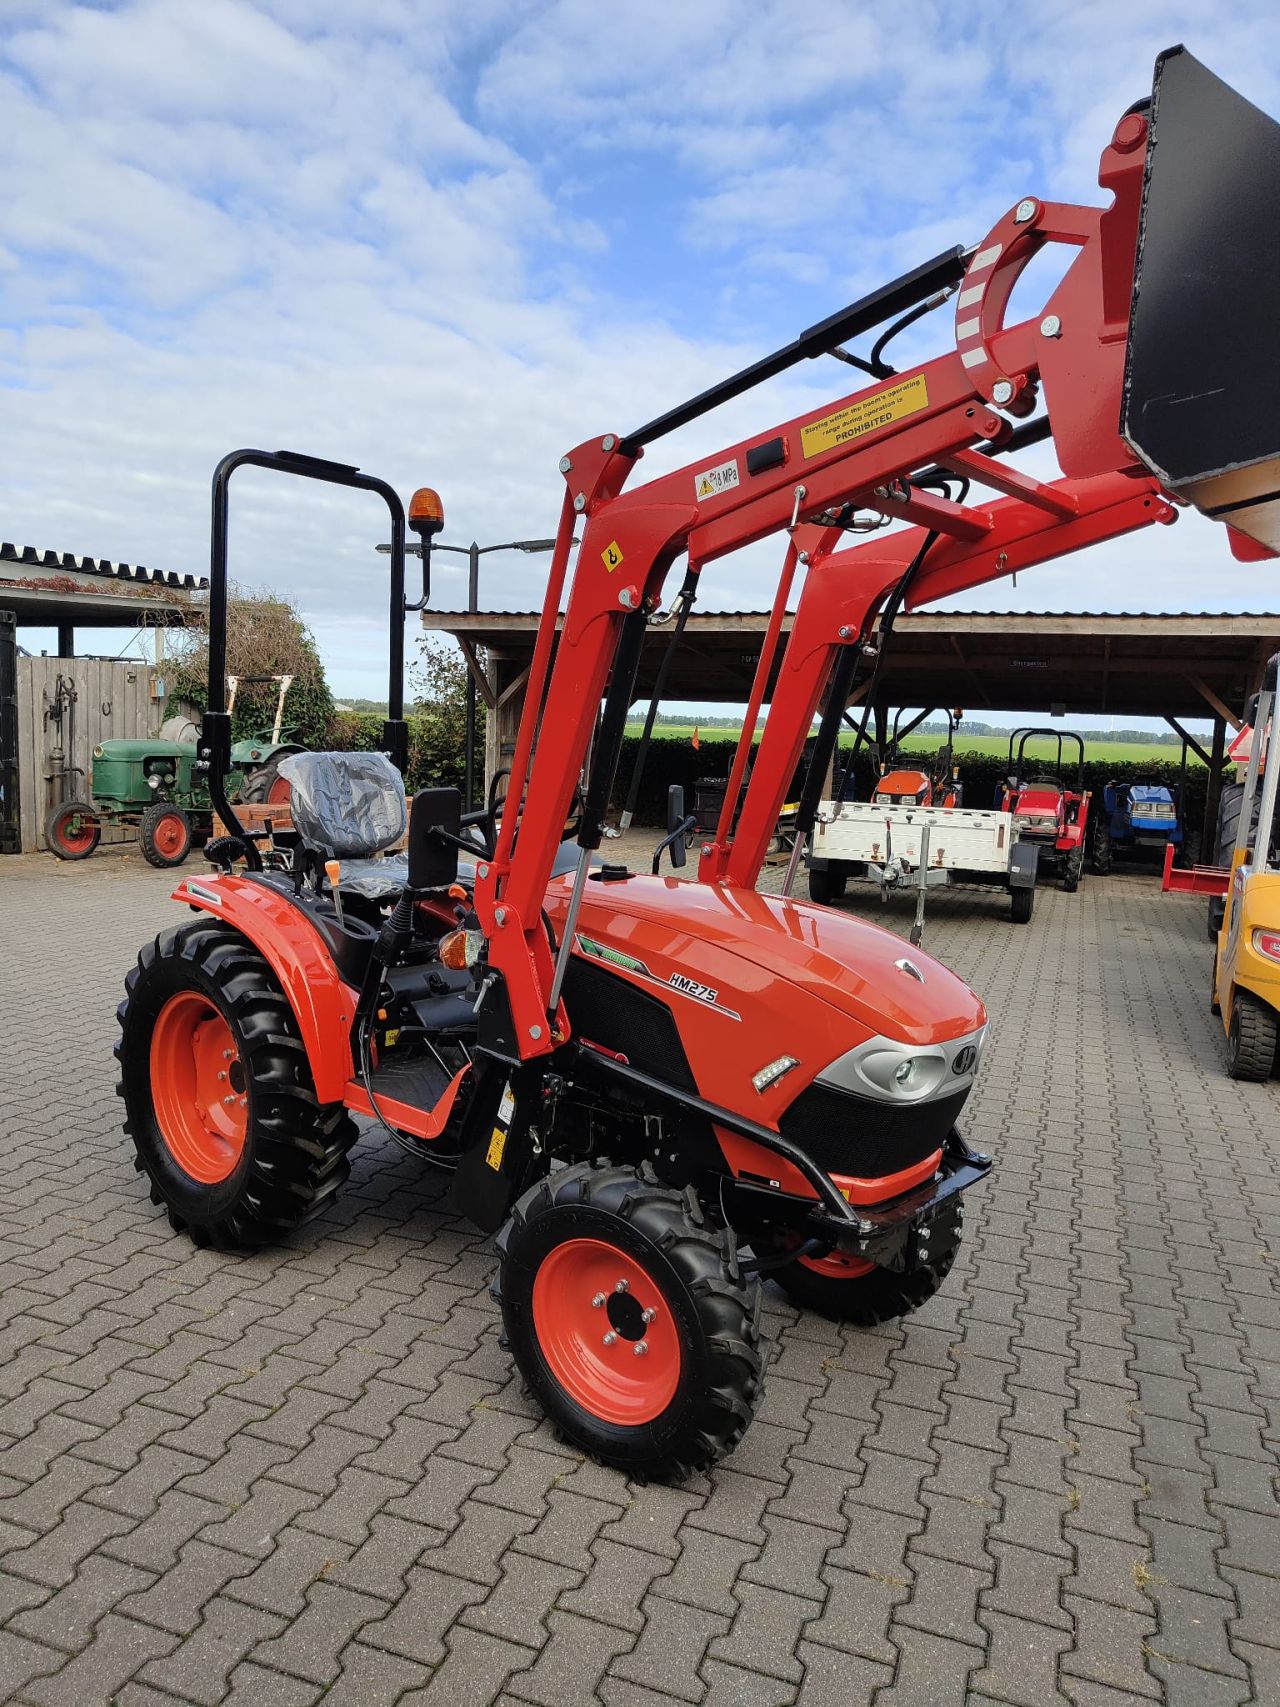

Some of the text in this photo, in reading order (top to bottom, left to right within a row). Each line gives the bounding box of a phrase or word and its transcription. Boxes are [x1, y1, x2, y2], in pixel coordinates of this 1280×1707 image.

[804, 379, 921, 435] Staying within the boom's operating
[822, 396, 904, 436] range during operation is
[835, 411, 893, 442] PROHIBITED
[723, 468, 738, 484] MPa
[669, 973, 717, 1001] HM275
